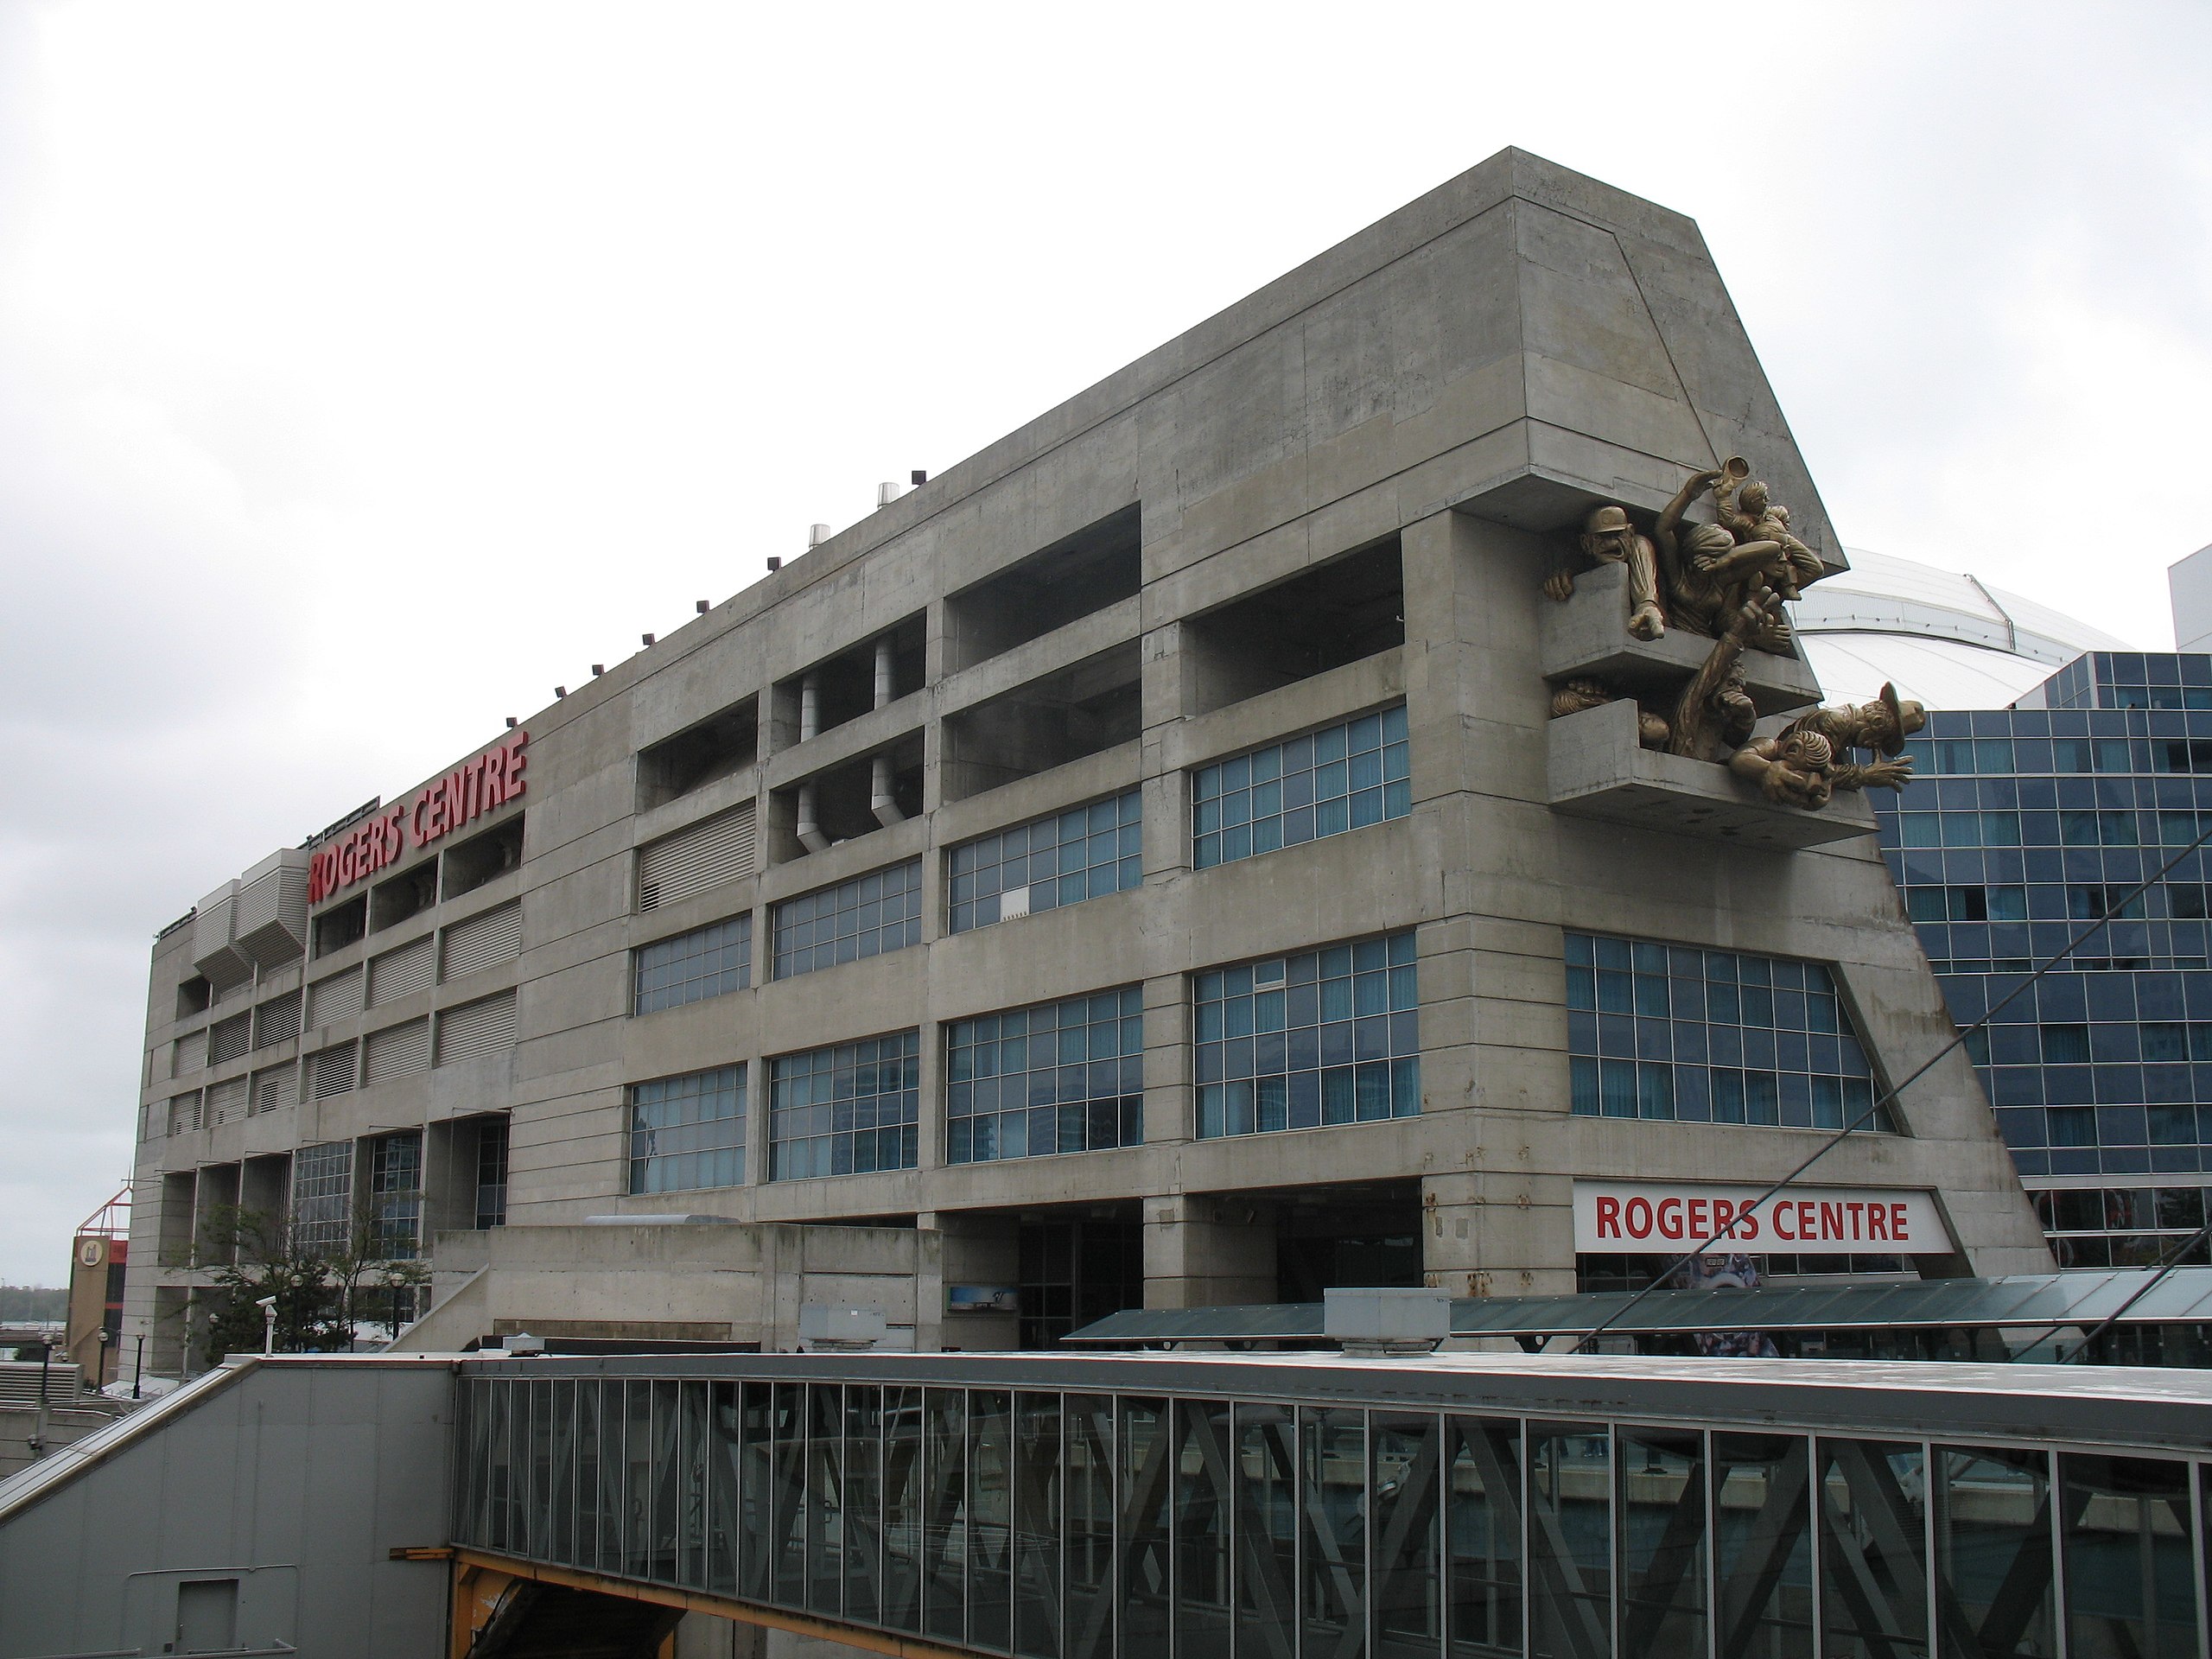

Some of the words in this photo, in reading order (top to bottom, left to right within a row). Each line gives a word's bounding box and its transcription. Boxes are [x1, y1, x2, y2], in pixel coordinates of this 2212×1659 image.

[308, 805, 404, 904] ROGERS
[410, 732, 529, 849] CENTRE
[1596, 1196, 1759, 1240] ROGERS
[1772, 1200, 1910, 1241] CENTRE
